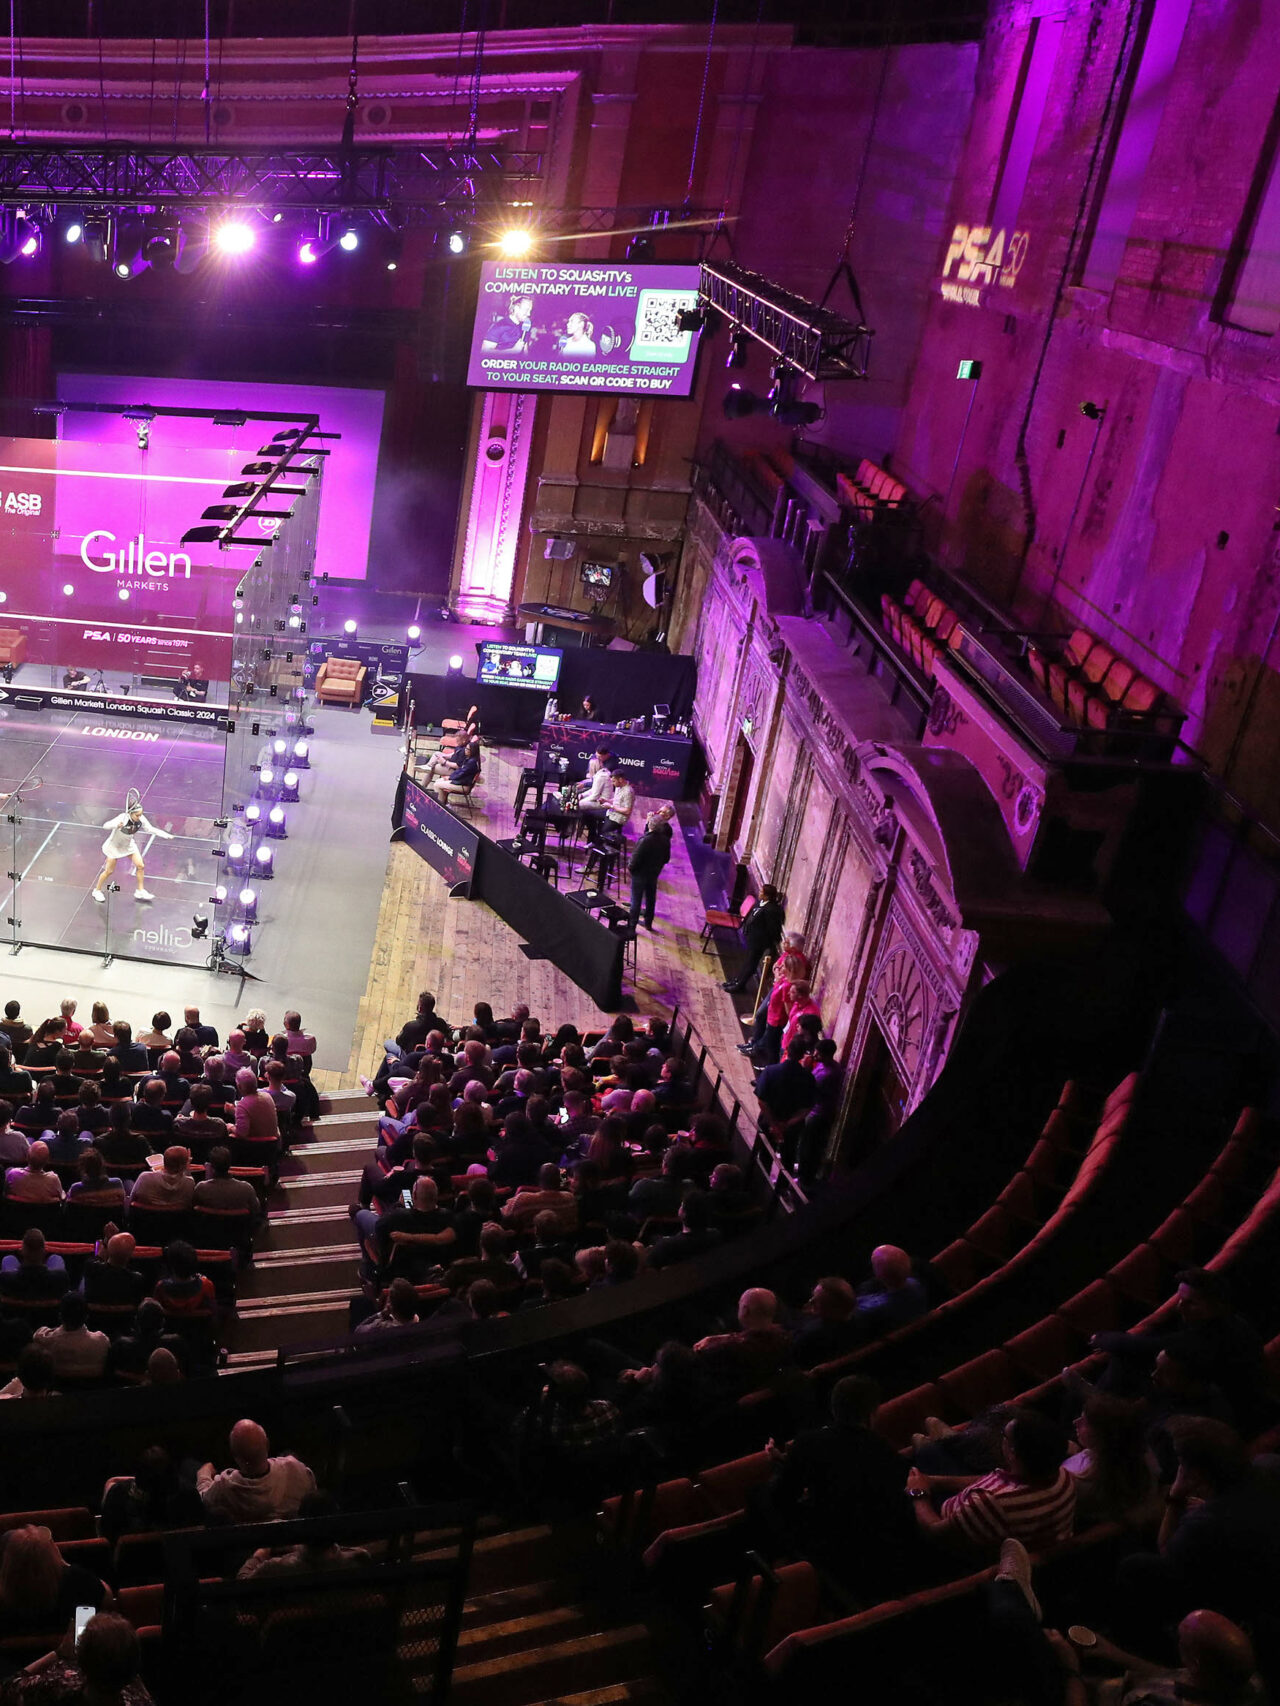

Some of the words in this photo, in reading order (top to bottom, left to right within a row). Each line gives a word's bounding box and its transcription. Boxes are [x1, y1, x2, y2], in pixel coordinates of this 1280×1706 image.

[942, 224, 1005, 284] PSA
[495, 268, 538, 280] LISTEN
[540, 269, 557, 280] TO
[558, 270, 632, 282] SQUASHTV's
[484, 282, 571, 296] COMMENTARY
[573, 284, 607, 296] TEAM
[608, 286, 638, 297] LIVE!
[481, 359, 518, 370] ORDER
[519, 360, 547, 371] YOUR
[549, 362, 580, 373] RADIO
[582, 363, 629, 374] EARPIECE
[631, 365, 680, 377] STRAIGHT
[486, 372, 501, 381] TO
[502, 372, 530, 382] YOUR
[532, 373, 560, 384] SEAT,
[560, 376, 589, 386] SCAN
[590, 376, 605, 387] QR
[606, 378, 635, 388] CODE
[636, 378, 649, 388] TO
[650, 379, 672, 390] BUY
[4, 492, 42, 510] ASB
[80, 530, 192, 579] Gillen
[116, 580, 169, 592] MARKETS
[83, 630, 111, 641] PSA
[50, 696, 73, 706] Gillen
[74, 698, 104, 709] Markets
[106, 702, 136, 712] London
[137, 705, 166, 716] Squash
[168, 708, 195, 718] Classic
[196, 711, 216, 720] 2024
[81, 726, 160, 742] LONDON
